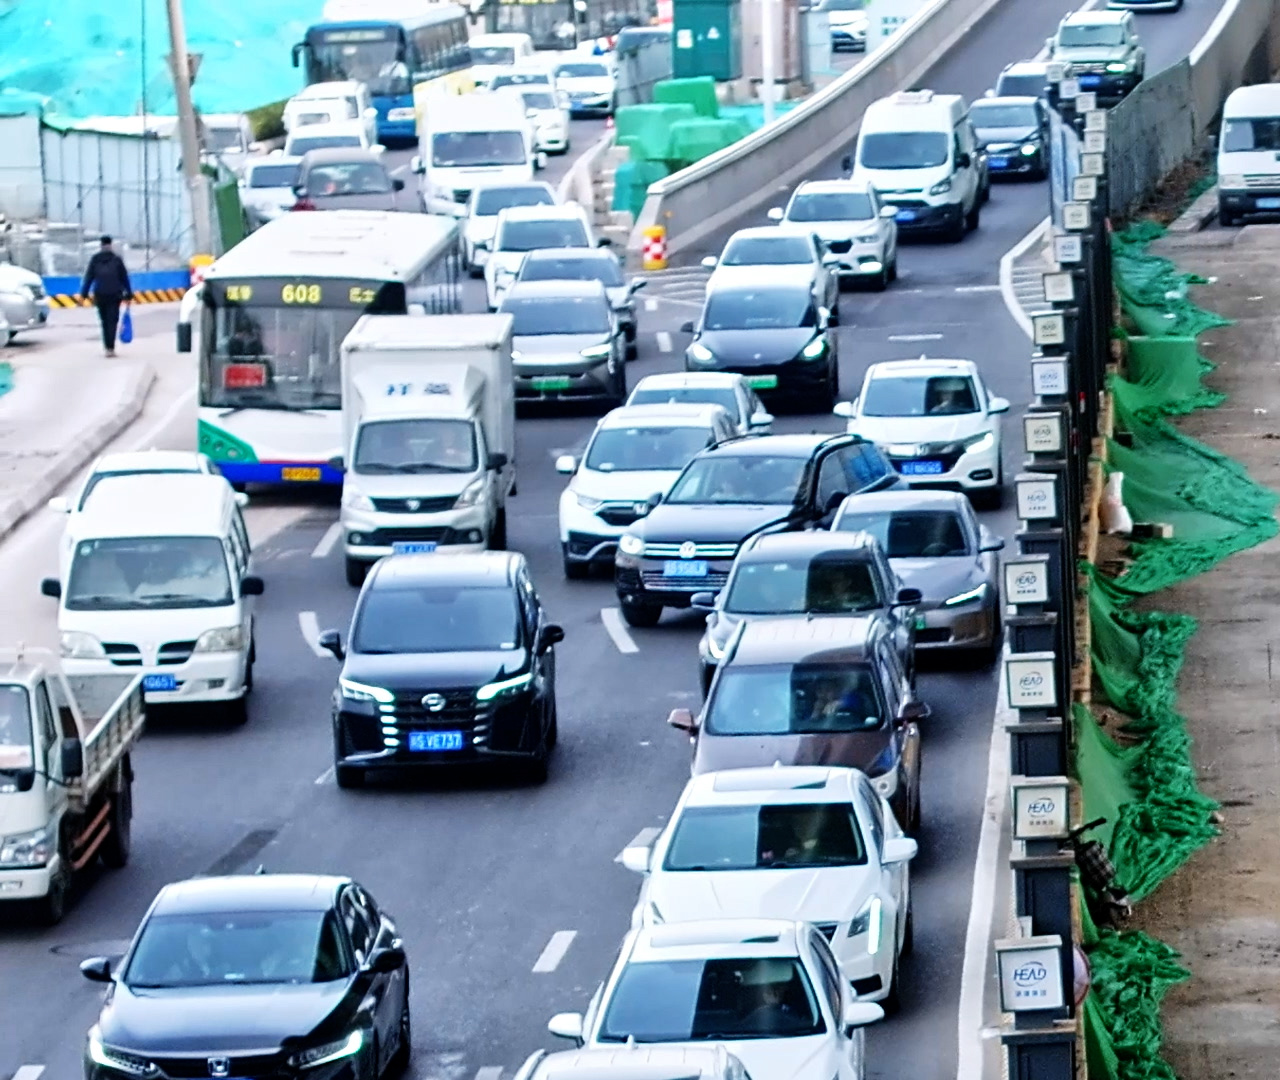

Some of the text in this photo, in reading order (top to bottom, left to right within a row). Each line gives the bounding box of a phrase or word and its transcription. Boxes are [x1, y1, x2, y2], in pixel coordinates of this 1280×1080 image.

[282, 284, 321, 304] 608
[1027, 803, 1055, 813] HEAD
[1013, 968, 1047, 981] HEAD
